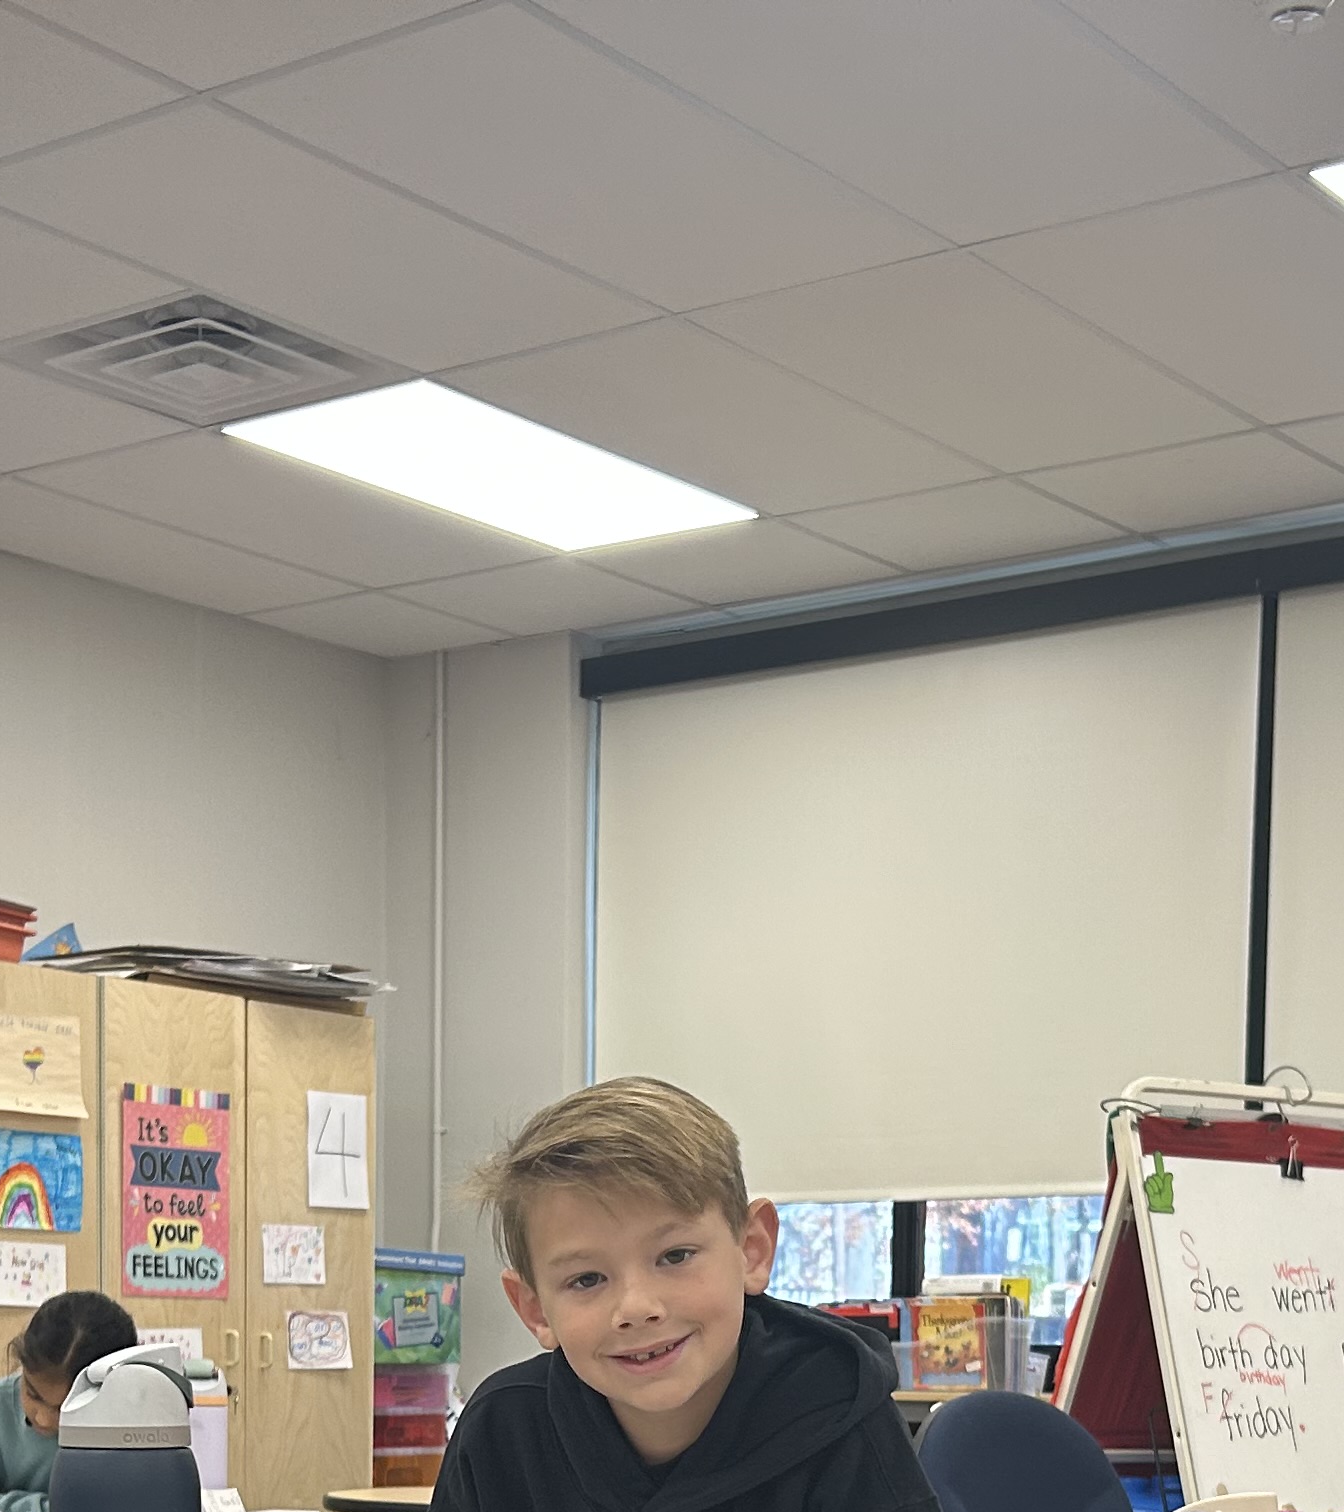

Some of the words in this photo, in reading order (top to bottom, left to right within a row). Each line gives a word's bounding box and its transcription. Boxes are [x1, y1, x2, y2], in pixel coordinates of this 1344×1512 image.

[137, 1117, 169, 1143] It's
[315, 1106, 361, 1198] 4
[139, 1151, 213, 1185] OKAY
[144, 1193, 163, 1214] to
[169, 1194, 206, 1218] feel
[152, 1222, 200, 1249] your
[131, 1253, 219, 1281] FEELINGS
[123, 1431, 169, 1444] owala
